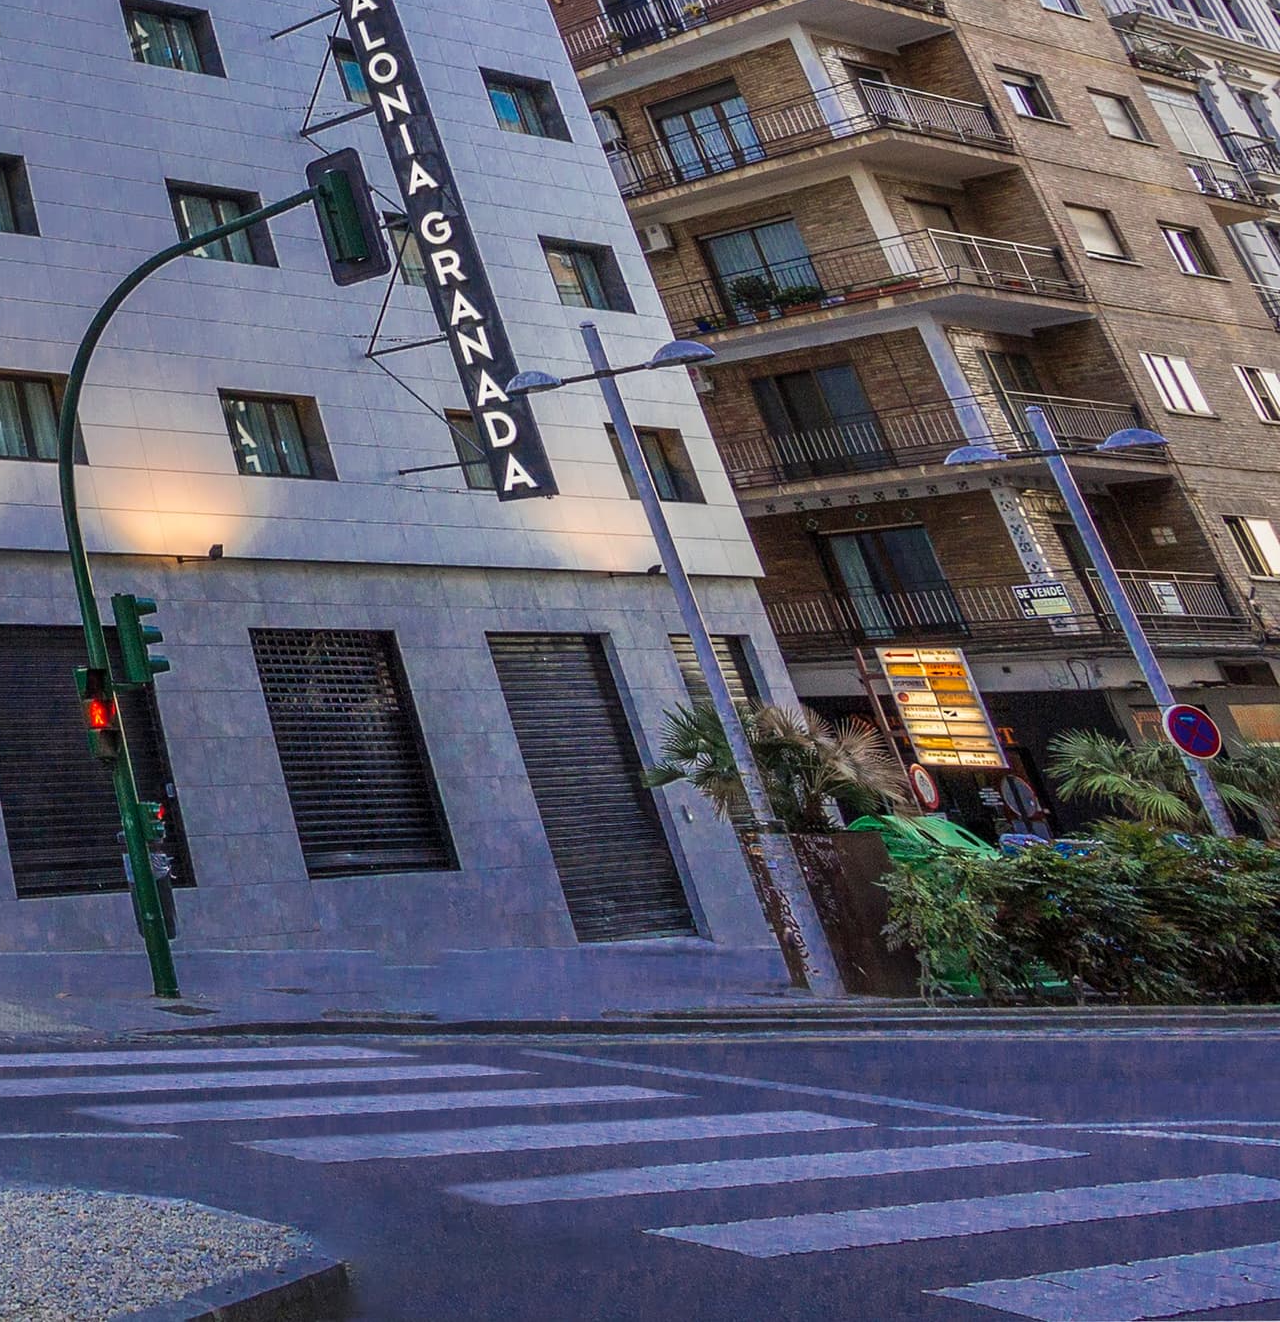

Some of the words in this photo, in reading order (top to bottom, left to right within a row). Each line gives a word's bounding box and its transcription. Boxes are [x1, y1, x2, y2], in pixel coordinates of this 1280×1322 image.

[419, 210, 539, 494] GRANADA
[1016, 588, 1030, 599] SE
[1029, 585, 1064, 598] VENDE
